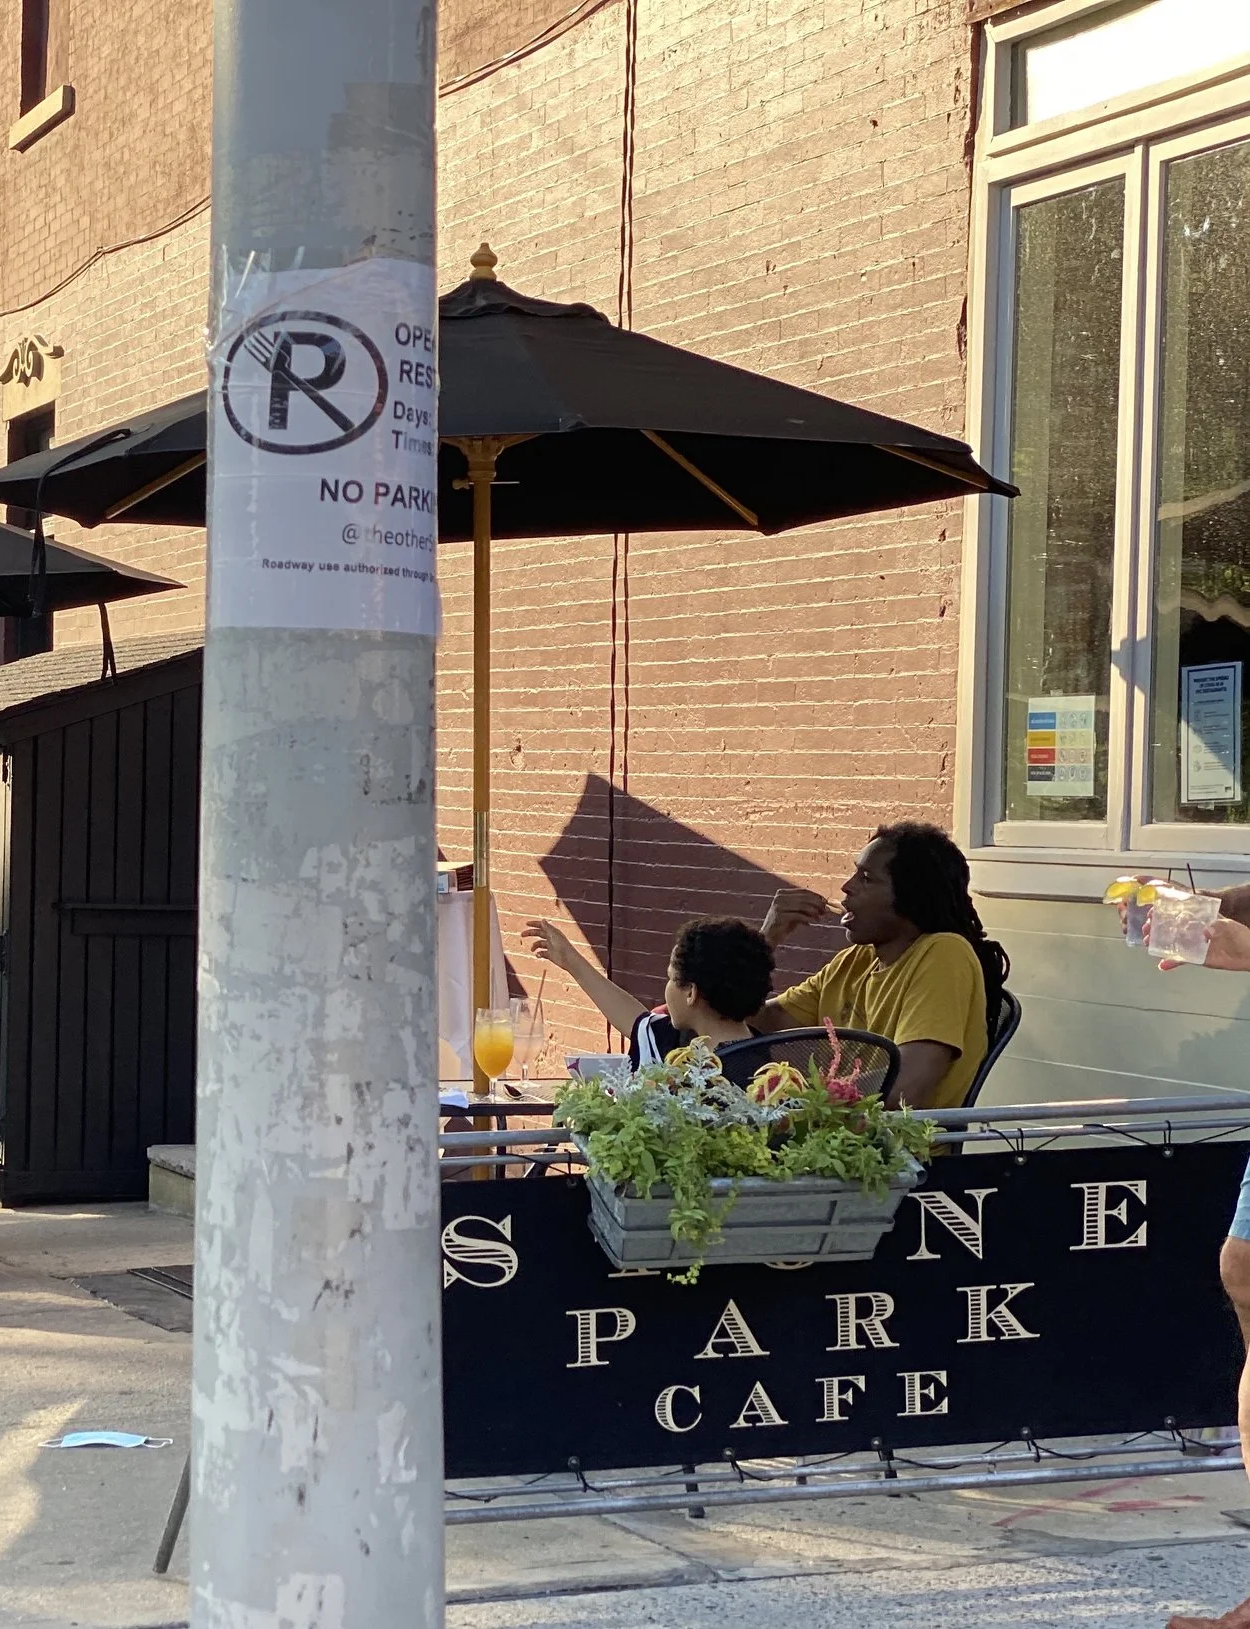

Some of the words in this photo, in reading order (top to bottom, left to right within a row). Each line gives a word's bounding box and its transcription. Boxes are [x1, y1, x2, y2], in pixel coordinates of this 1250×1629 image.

[395, 322, 435, 354] OPE
[399, 359, 436, 389] RES
[320, 478, 364, 504] NO
[373, 481, 436, 514] PARKI
[262, 558, 315, 572] Roadway
[319, 562, 340, 572] use
[344, 562, 400, 577] authorized
[441, 1179, 1149, 1289] SNE
[565, 1282, 1042, 1369] PARK
[654, 1370, 949, 1433] CAFE
